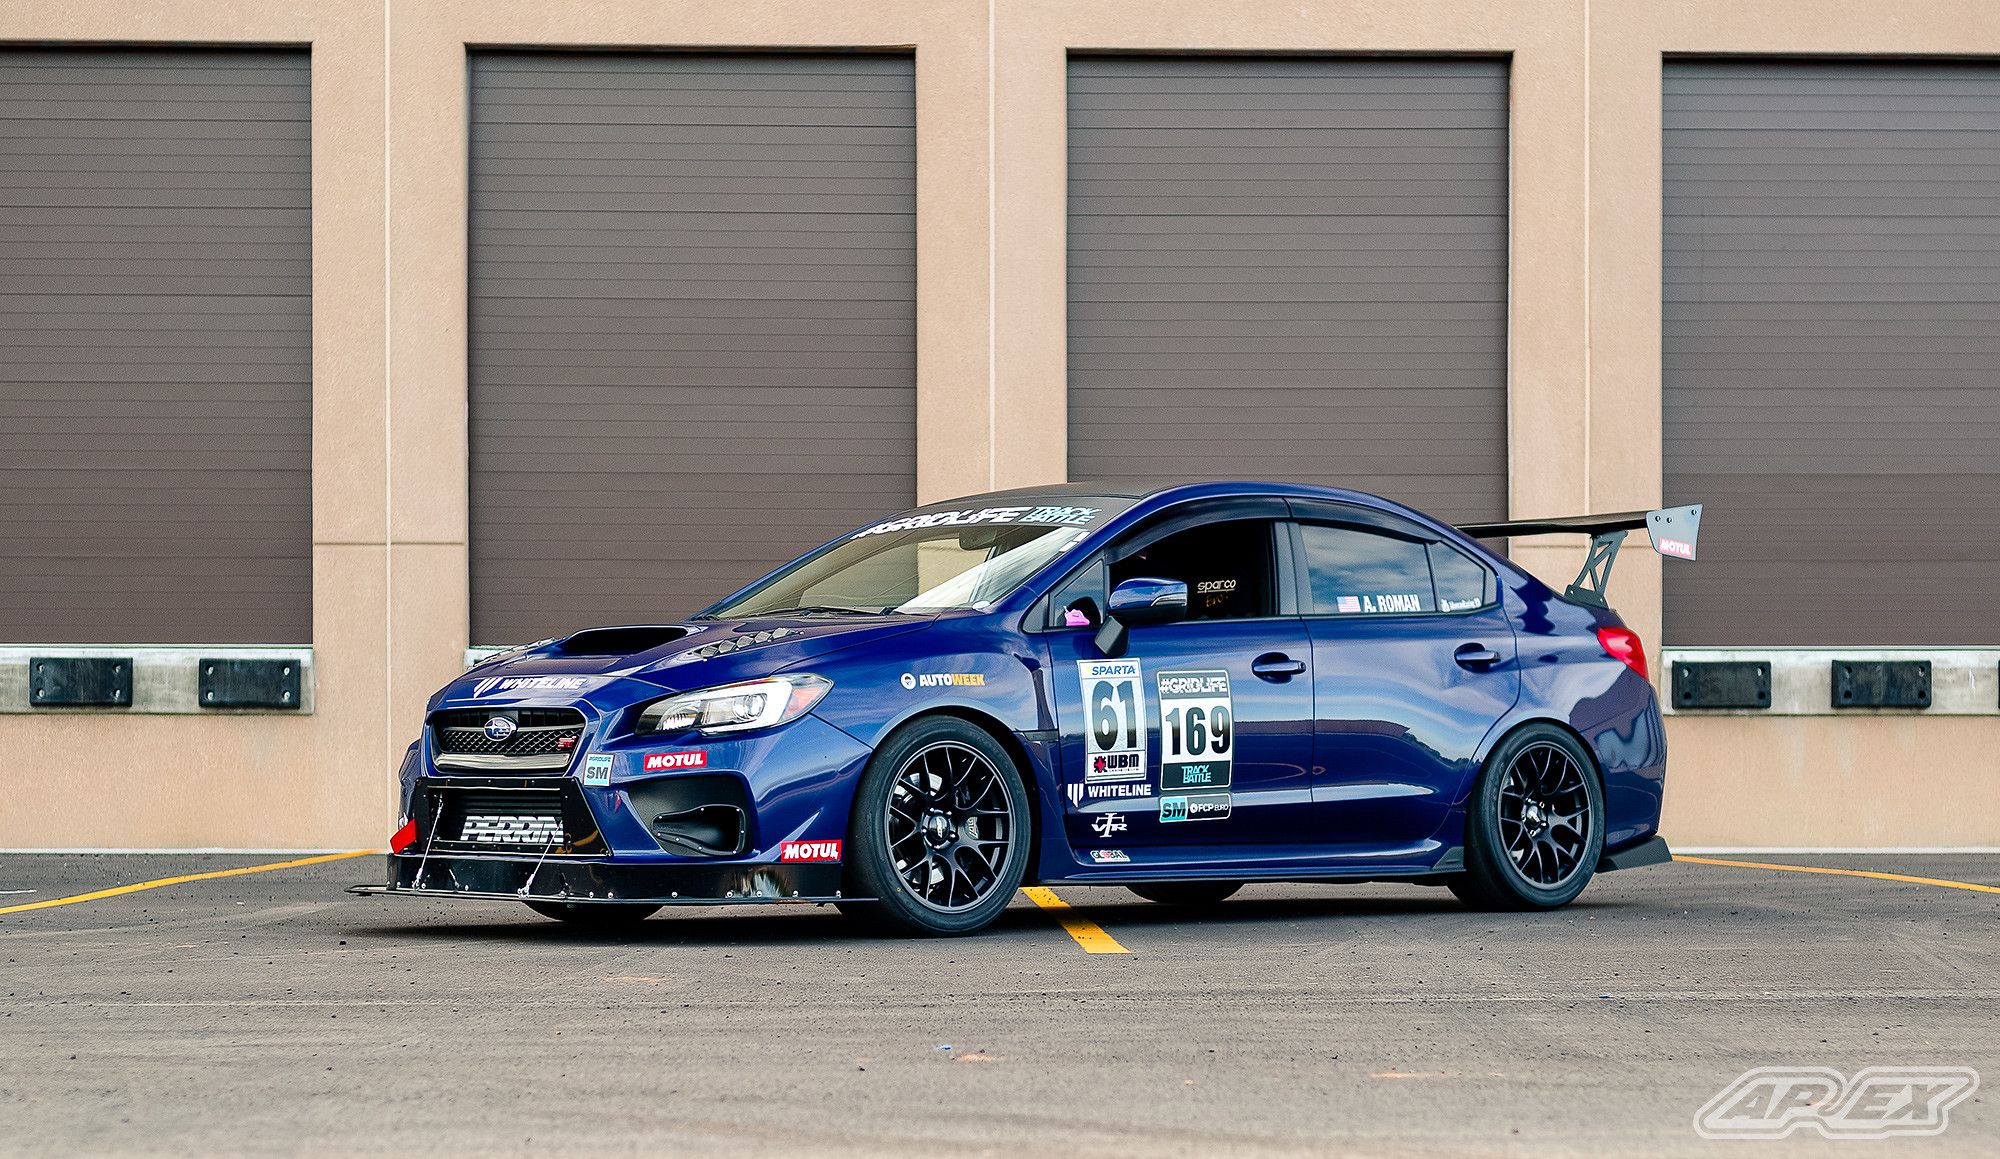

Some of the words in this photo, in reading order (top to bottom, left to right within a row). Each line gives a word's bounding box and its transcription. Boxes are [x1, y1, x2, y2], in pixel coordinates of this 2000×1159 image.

[1028, 506, 1102, 516] TRACK
[1018, 514, 1095, 525] BATTLE
[1660, 540, 1692, 555] MOTUL
[1197, 579, 1236, 593] sparco
[1363, 595, 1377, 613] A.
[1376, 594, 1421, 612] ROMAN
[1092, 665, 1136, 676] SPARTA
[499, 678, 587, 690] WHITELINE
[919, 673, 986, 687] AUTOWEEK
[1160, 677, 1228, 694] #GRIDLIFE
[1092, 680, 1137, 751] 61
[1165, 705, 1231, 756] 169
[646, 753, 704, 769] MOTUL
[1107, 753, 1140, 769] WBM
[586, 766, 609, 780] SM
[1181, 764, 1210, 774] TRACK
[1183, 772, 1212, 784] BATTLE
[1088, 784, 1152, 798] WHITELINE
[1161, 802, 1186, 818] SM
[1198, 802, 1214, 813] FCP
[460, 815, 564, 843] PERRIN
[783, 842, 839, 860] MOTUL
